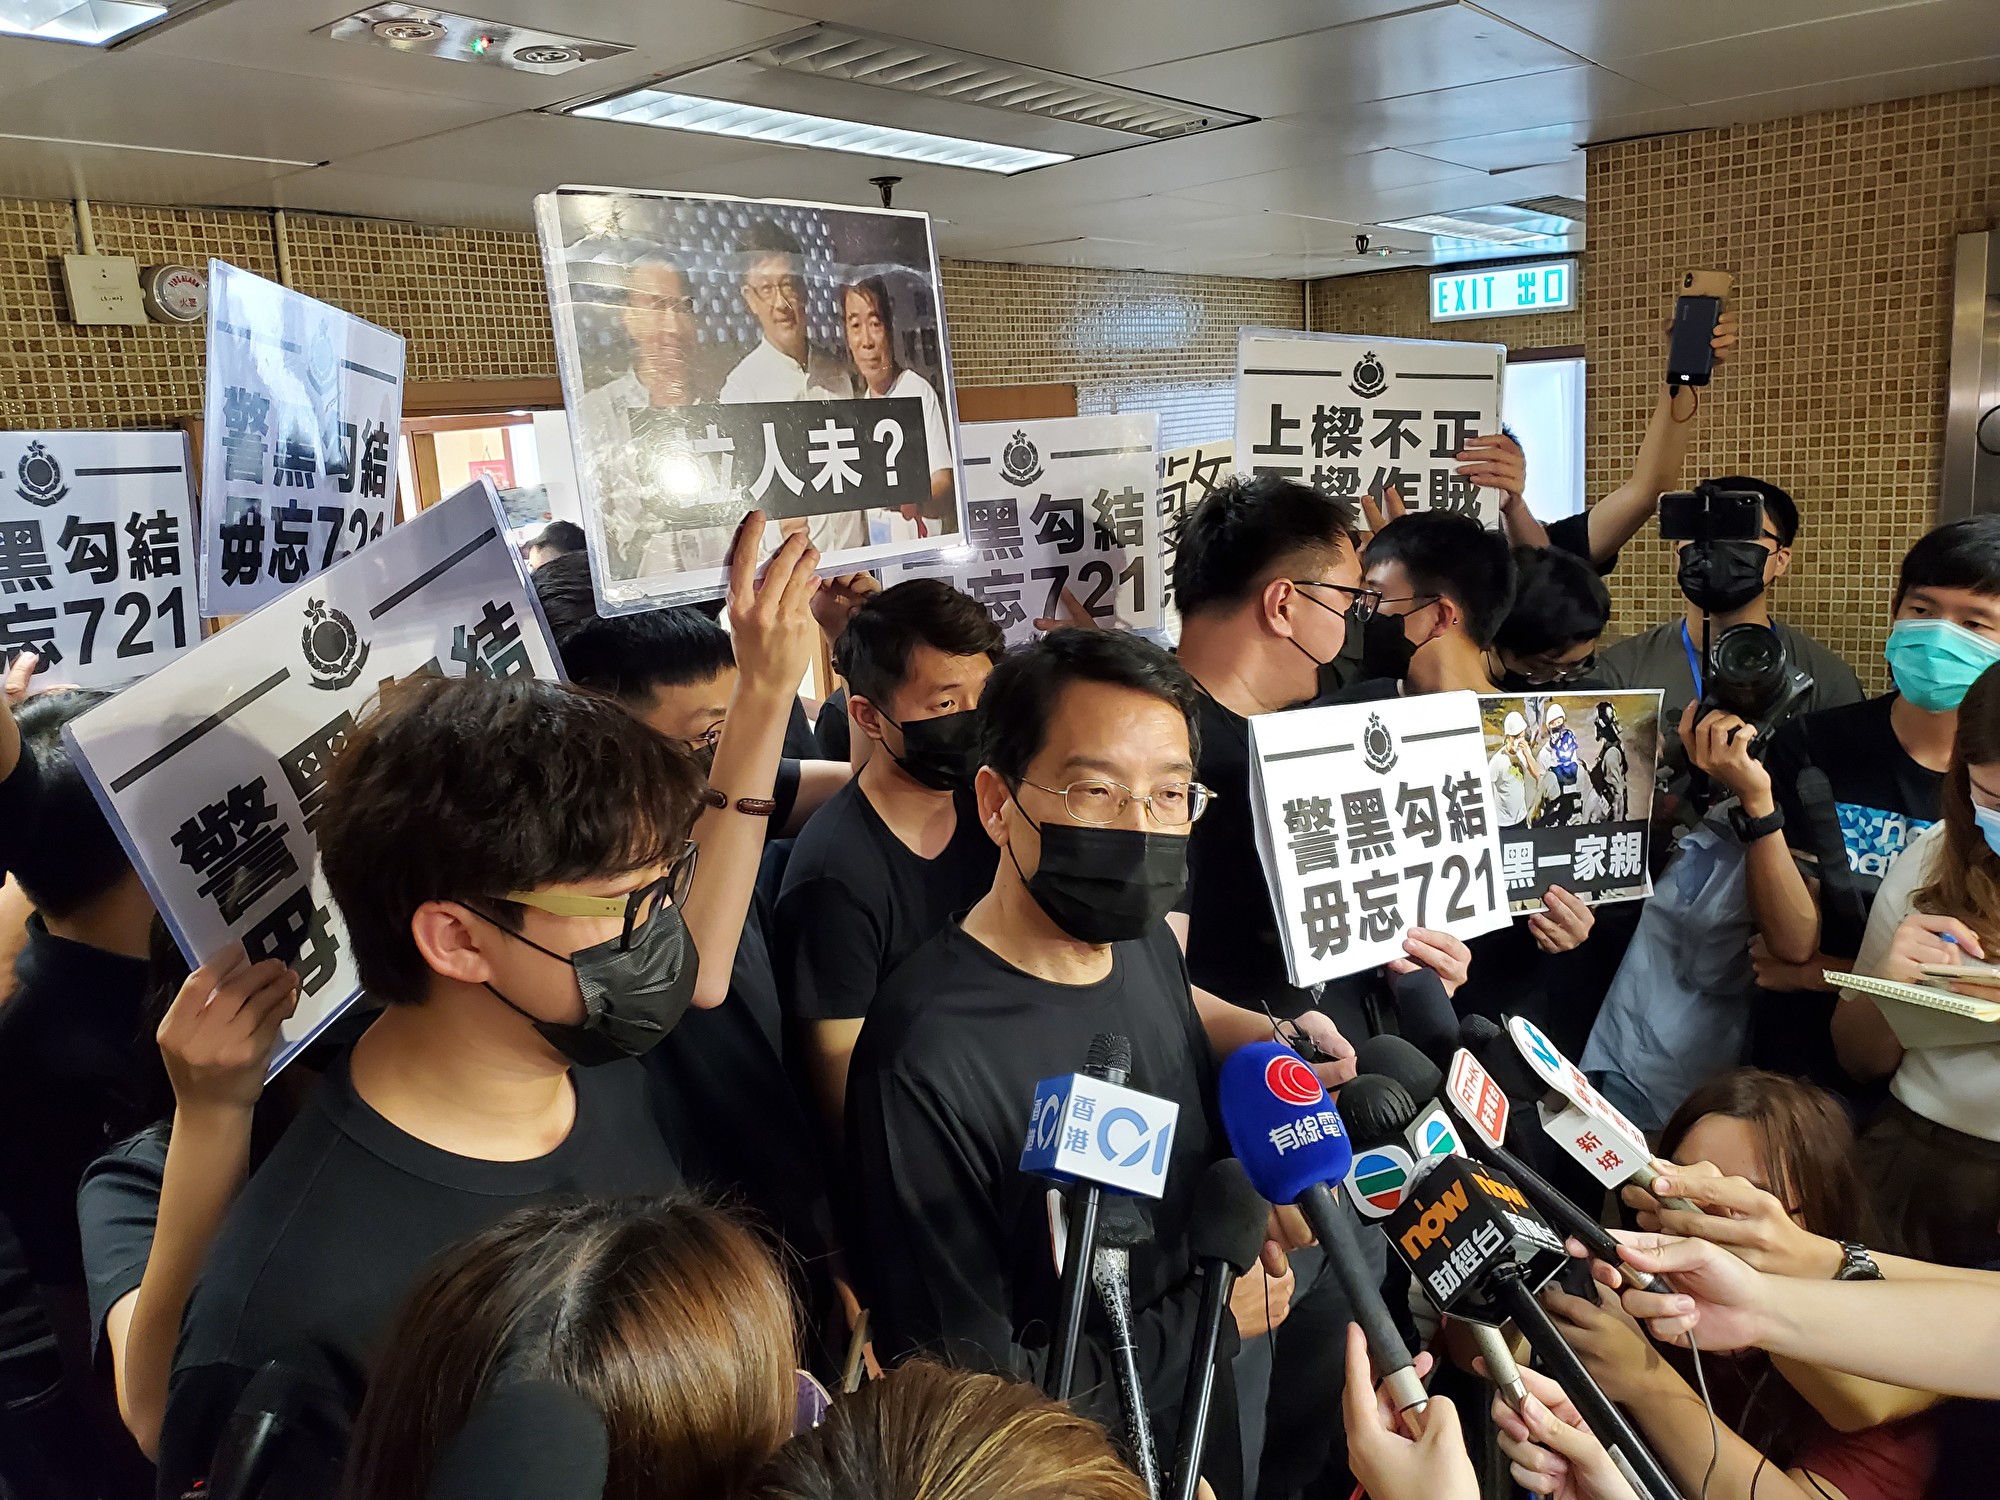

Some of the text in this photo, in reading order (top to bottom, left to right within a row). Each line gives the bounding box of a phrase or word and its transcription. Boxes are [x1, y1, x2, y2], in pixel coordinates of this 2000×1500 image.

[1439, 269, 1562, 313] EXIT 出口
[1252, 403, 1481, 459] 上樑不正
[1253, 465, 1481, 519] 樑作賊
[968, 486, 1144, 561] 黑勾結
[933, 556, 1144, 630] 忘721
[1282, 770, 1488, 876] 警黑勾結
[1503, 832, 1642, 890] 黑一家親
[1300, 848, 1496, 961] 毋忘721
[1462, 1061, 1480, 1107] RTHK
[1064, 1094, 1097, 1155] 香港
[1269, 1112, 1341, 1155] 有線電
[1575, 1130, 1624, 1172] 新城
[1470, 1167, 1530, 1214] now
[1400, 1179, 1470, 1261] now
[1428, 1219, 1505, 1301] 財經台
